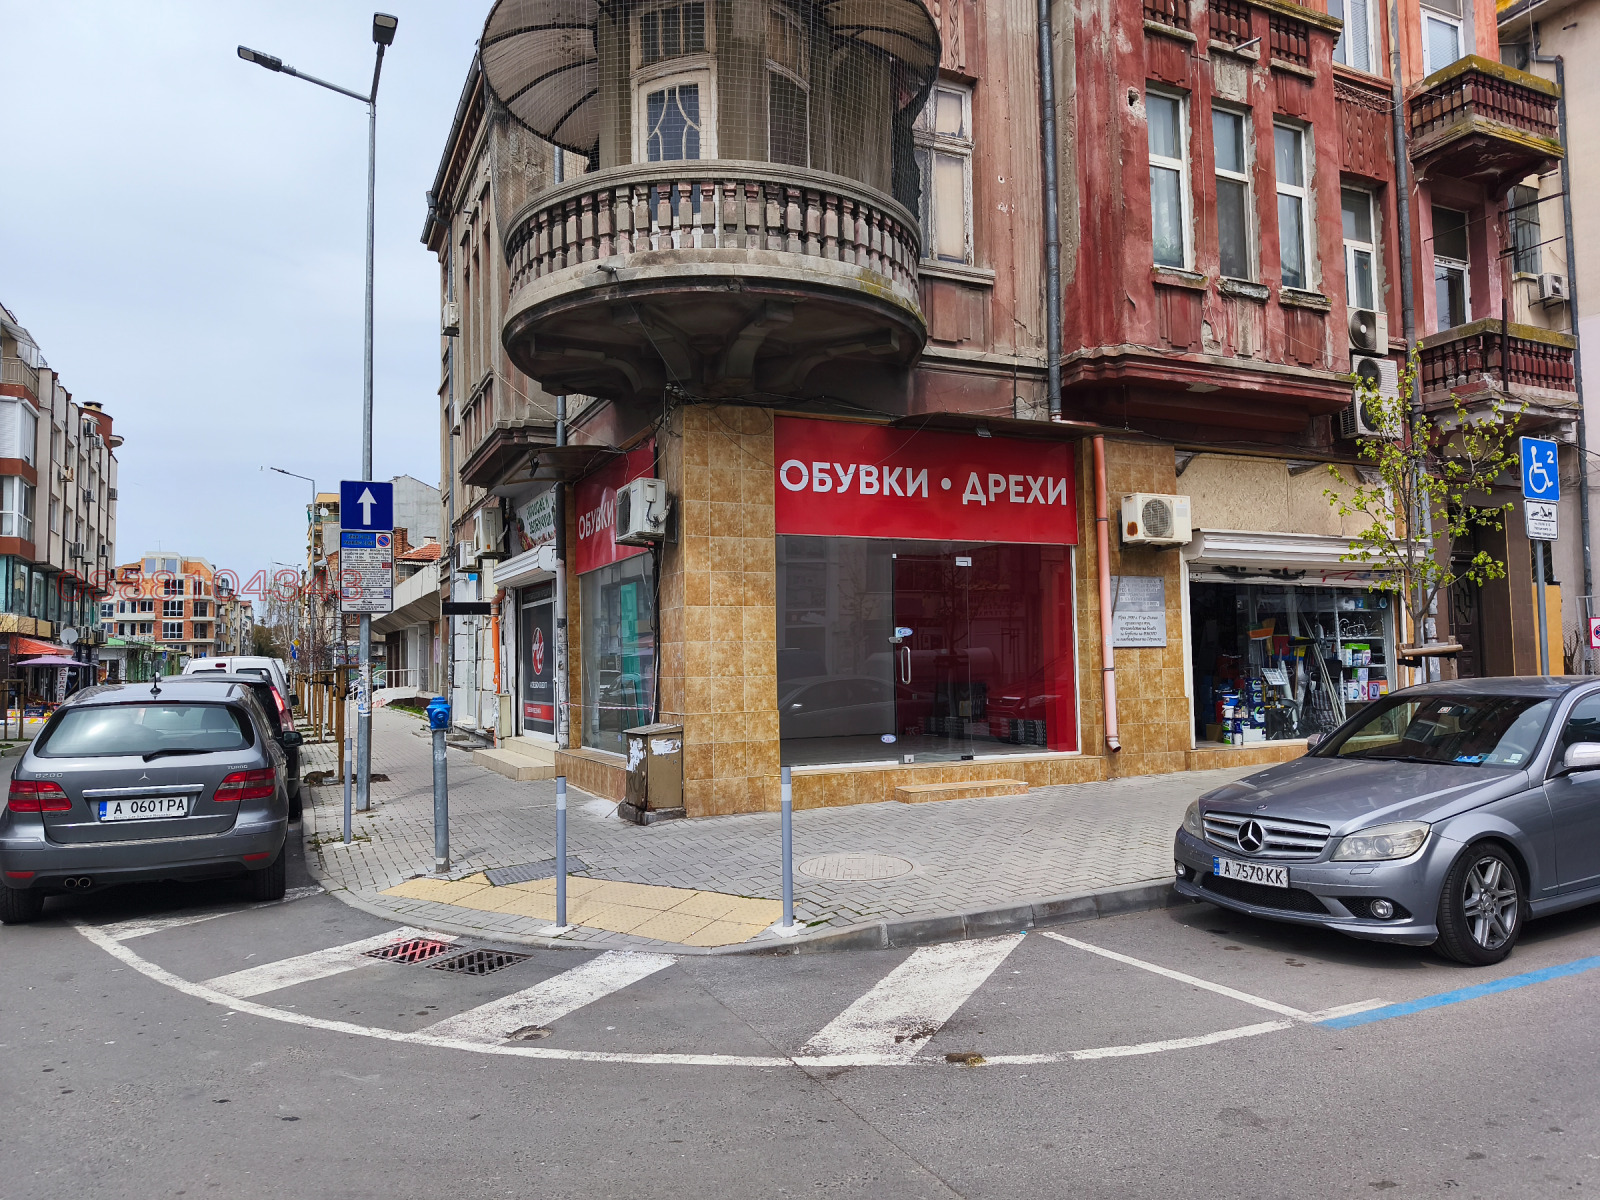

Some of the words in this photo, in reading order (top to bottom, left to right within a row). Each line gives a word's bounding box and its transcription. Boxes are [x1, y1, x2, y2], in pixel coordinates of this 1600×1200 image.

[1546, 450, 1555, 464] 2
[779, 459, 929, 498] ОБУВКИ
[962, 472, 1067, 506] ДРЕХИ
[578, 498, 614, 540] ОБУВКИ
[114, 802, 123, 815] A
[1224, 861, 1231, 876] A
